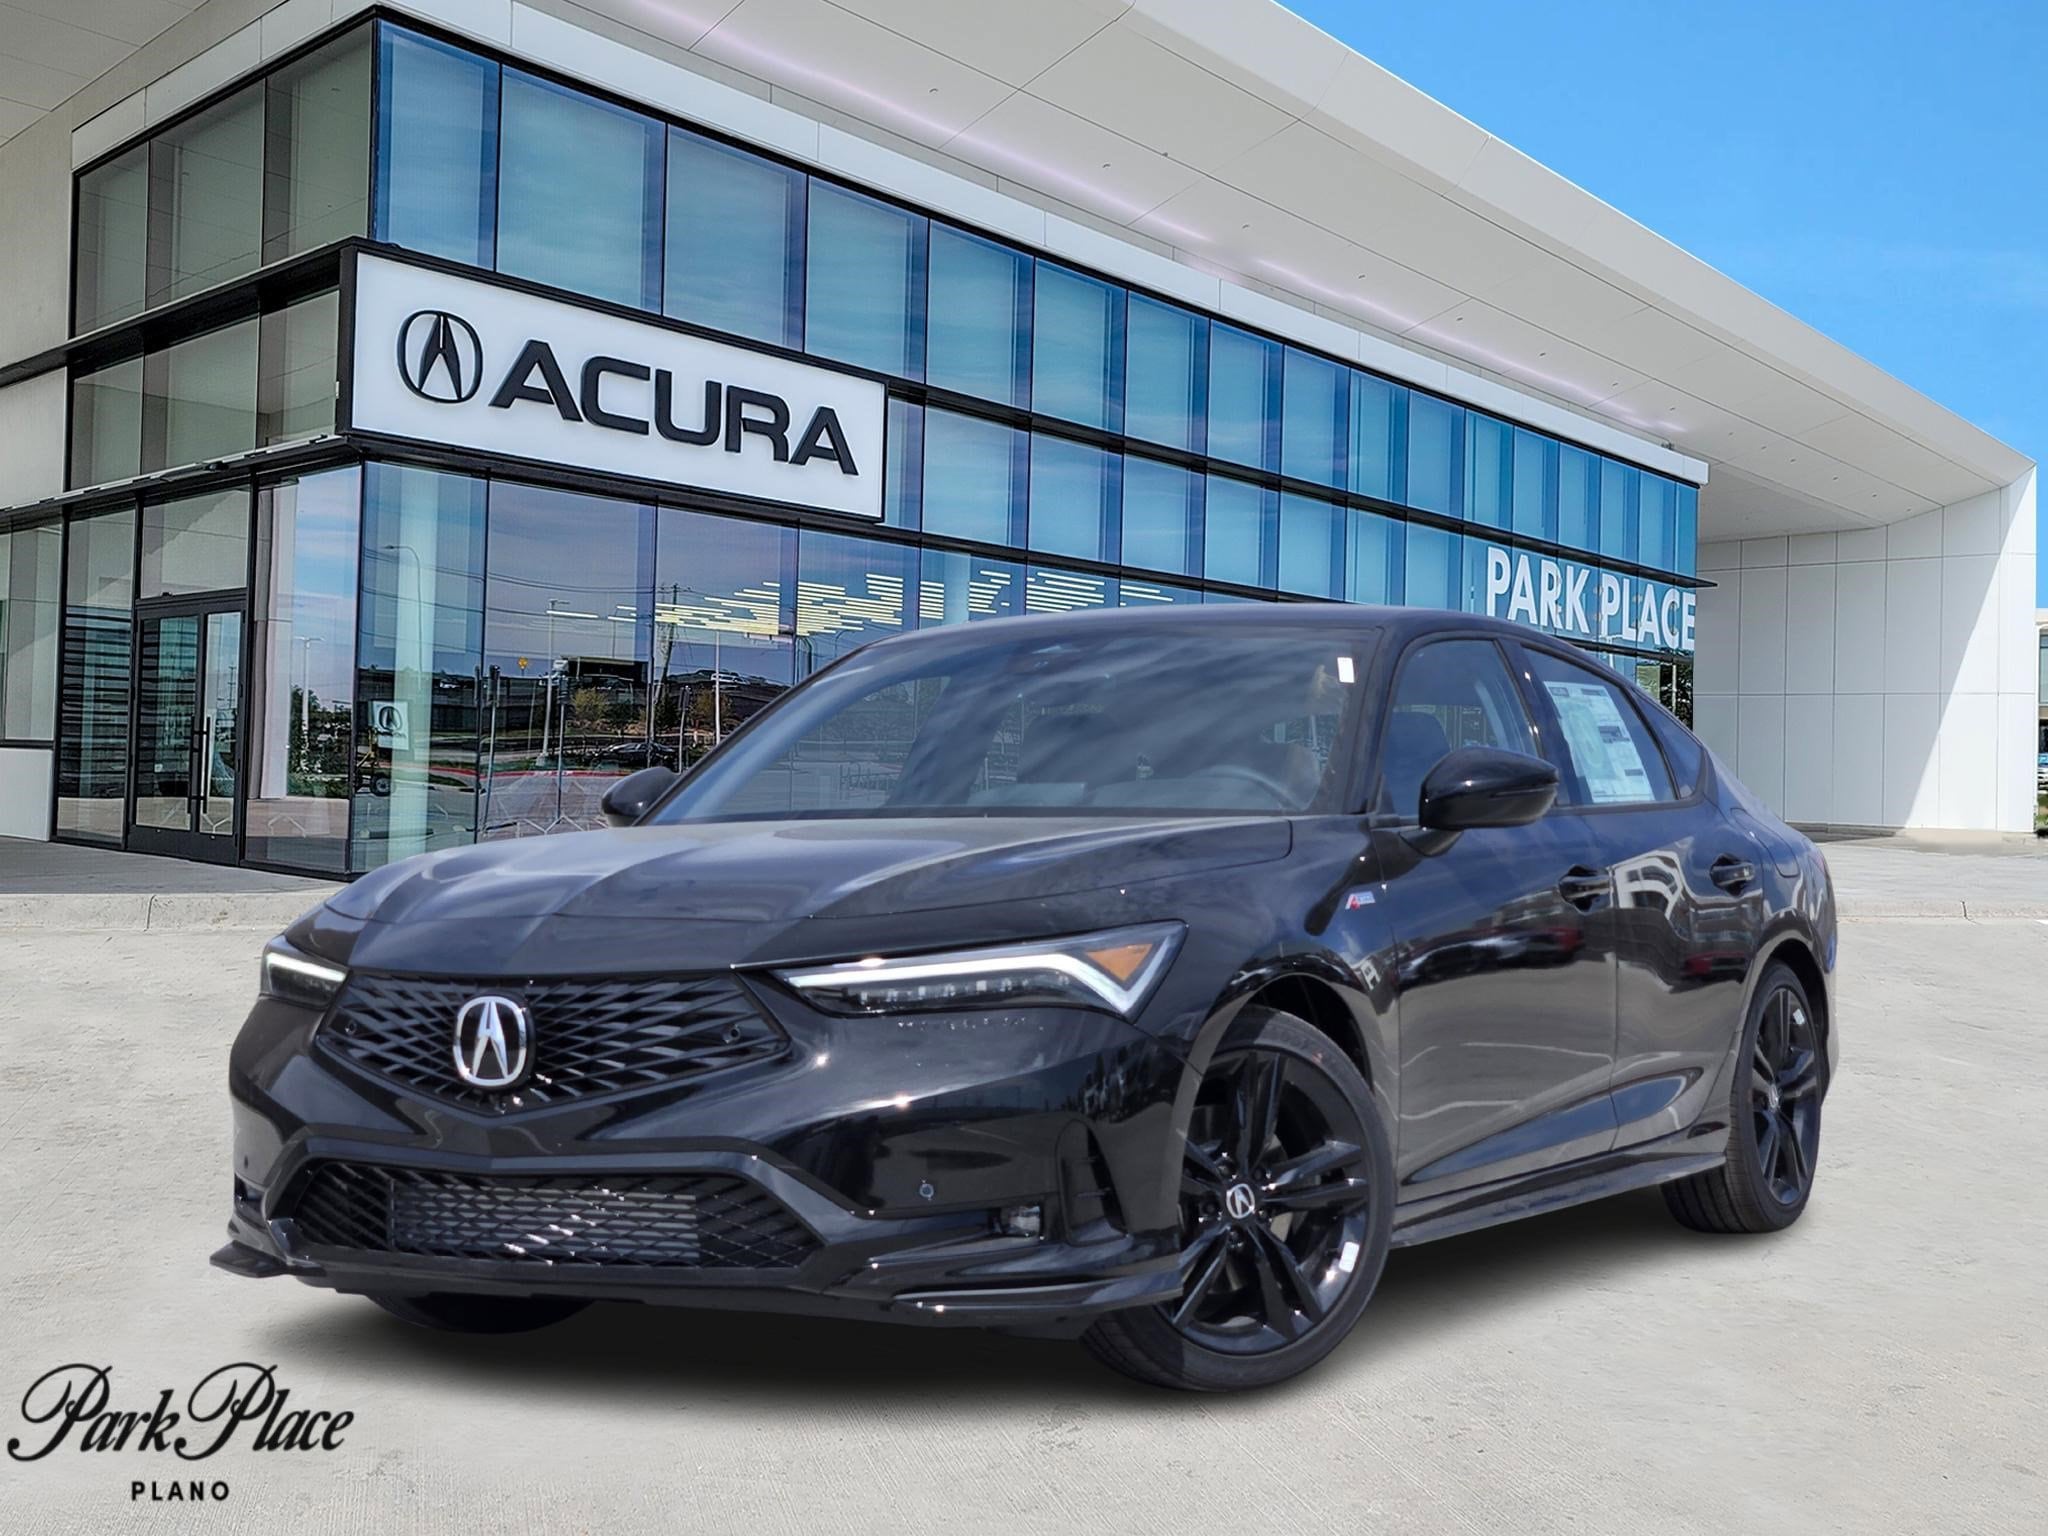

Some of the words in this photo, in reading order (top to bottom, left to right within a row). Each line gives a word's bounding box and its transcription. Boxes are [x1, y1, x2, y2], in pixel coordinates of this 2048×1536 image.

[489, 339, 859, 476] ACURA
[1486, 546, 1590, 634] PARK
[1601, 573, 1696, 651] PLACE
